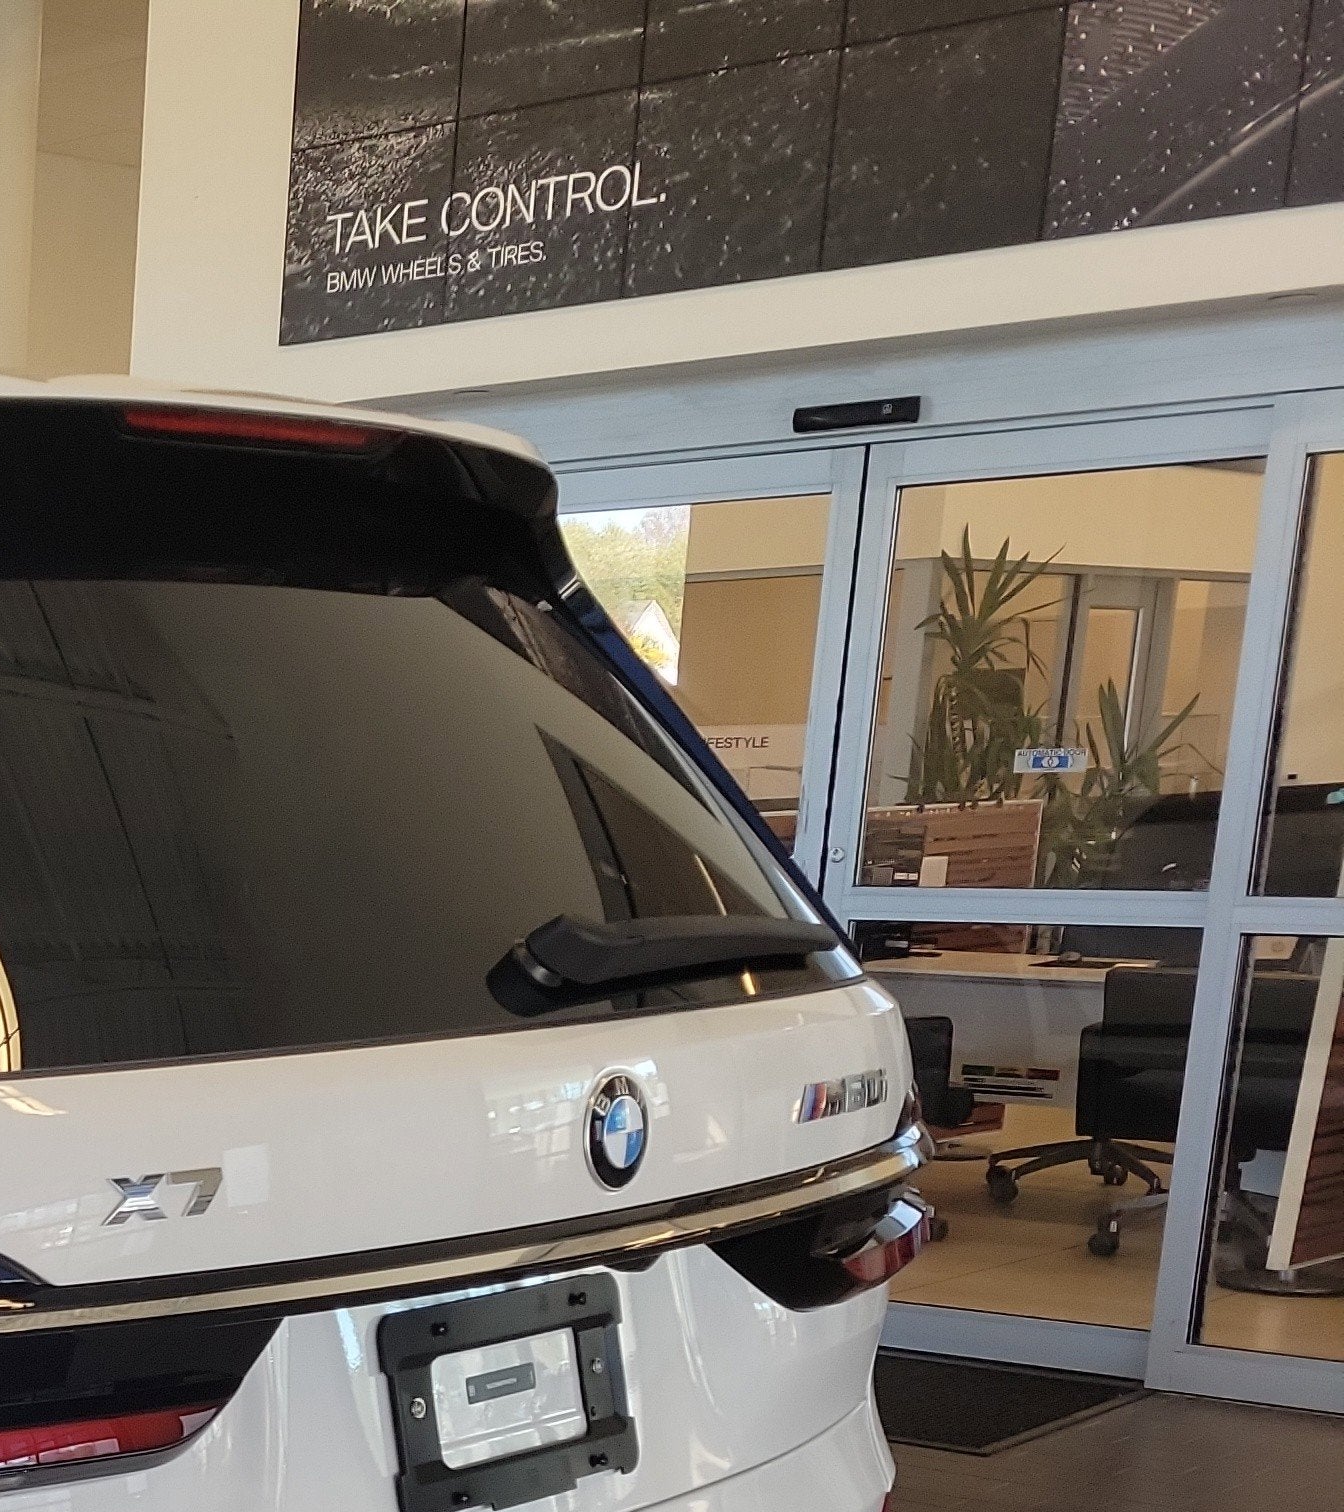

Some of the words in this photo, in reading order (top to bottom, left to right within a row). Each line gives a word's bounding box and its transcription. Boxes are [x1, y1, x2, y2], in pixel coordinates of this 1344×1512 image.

[326, 199, 429, 255] TAKE
[440, 161, 667, 237] CONTROL.
[326, 265, 377, 293] BMW
[382, 253, 463, 285] WHEELS
[467, 249, 482, 272] &
[487, 241, 548, 268] TIRES.
[707, 736, 769, 749] FESTYLE
[100, 1166, 223, 1227] X7
